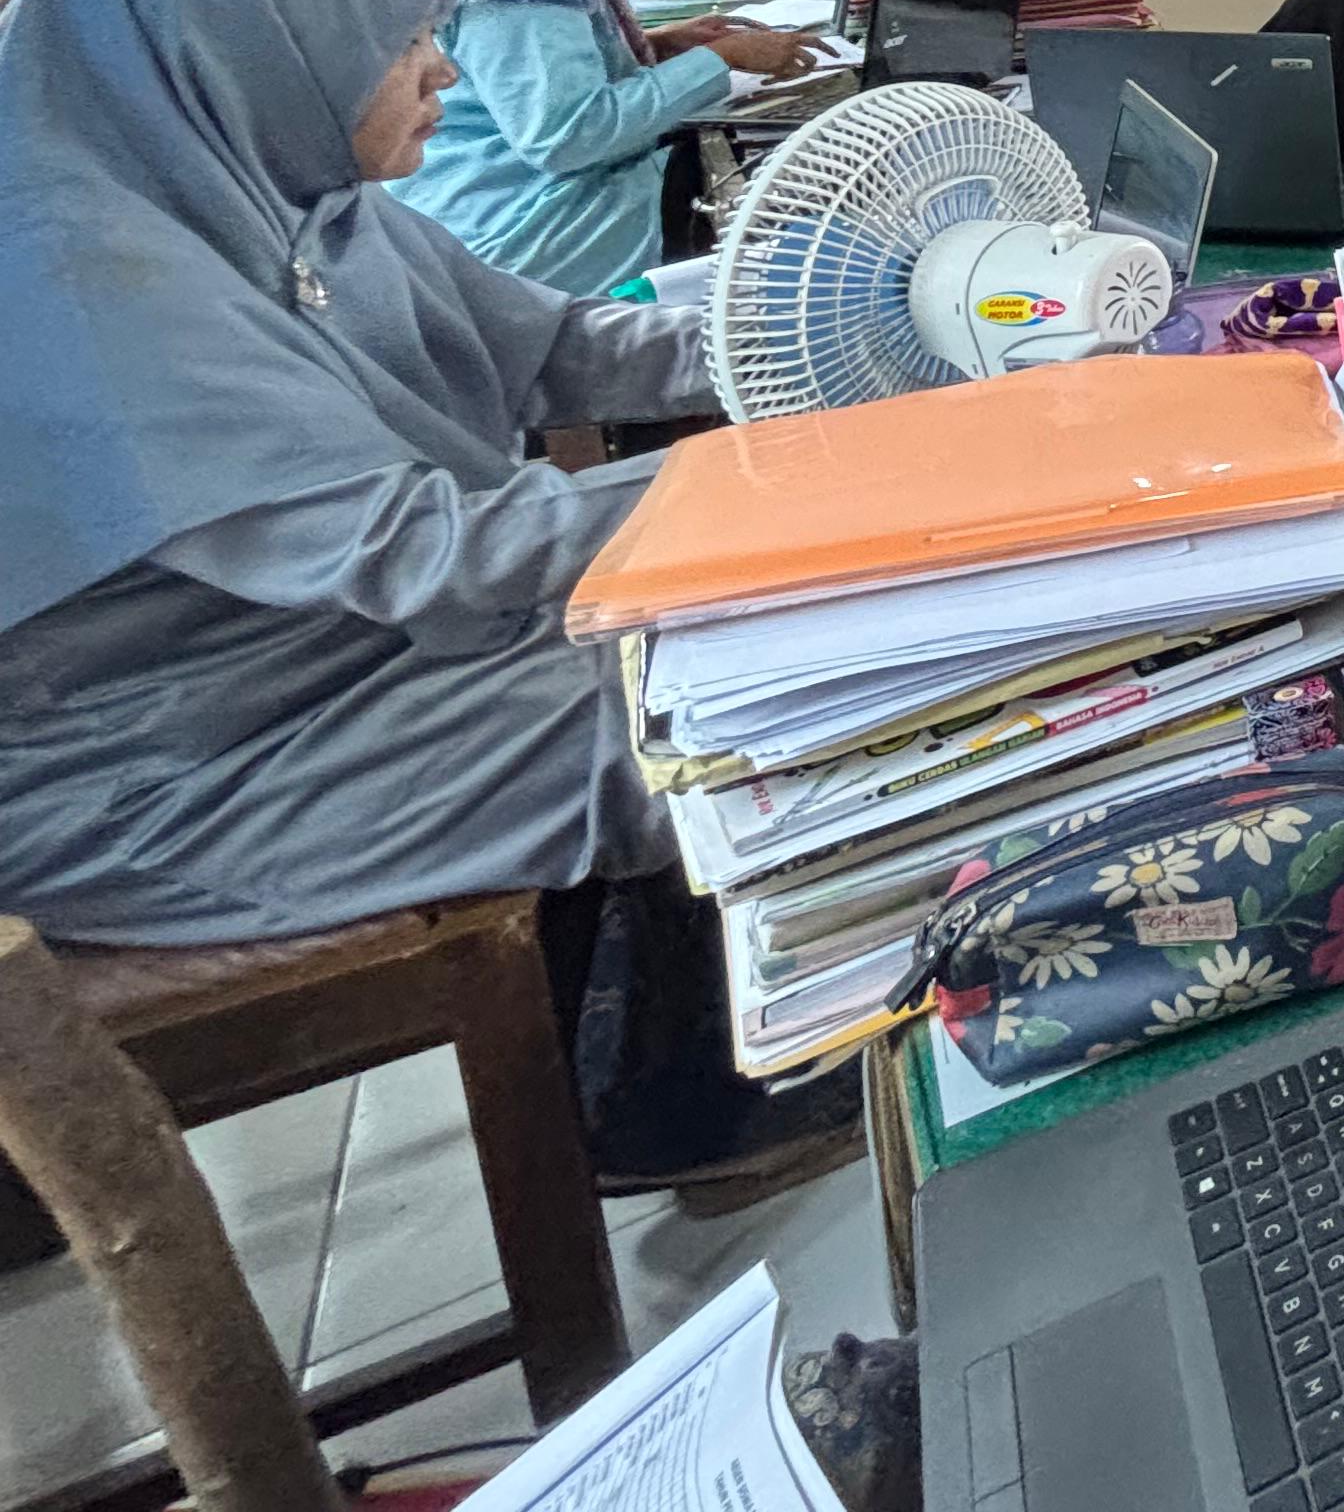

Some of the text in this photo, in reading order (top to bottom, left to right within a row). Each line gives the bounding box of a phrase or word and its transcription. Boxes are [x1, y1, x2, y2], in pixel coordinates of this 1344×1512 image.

[987, 311, 1024, 320] MOTOR
[1053, 709, 1094, 730] BAHASA
[1328, 1094, 1344, 1108] Q
[1297, 1152, 1314, 1165] S
[1306, 1183, 1323, 1198] D
[1317, 1217, 1335, 1230] F
[1327, 1254, 1344, 1271] G
[1246, 1155, 1324, 1398] Z X C V B N M
